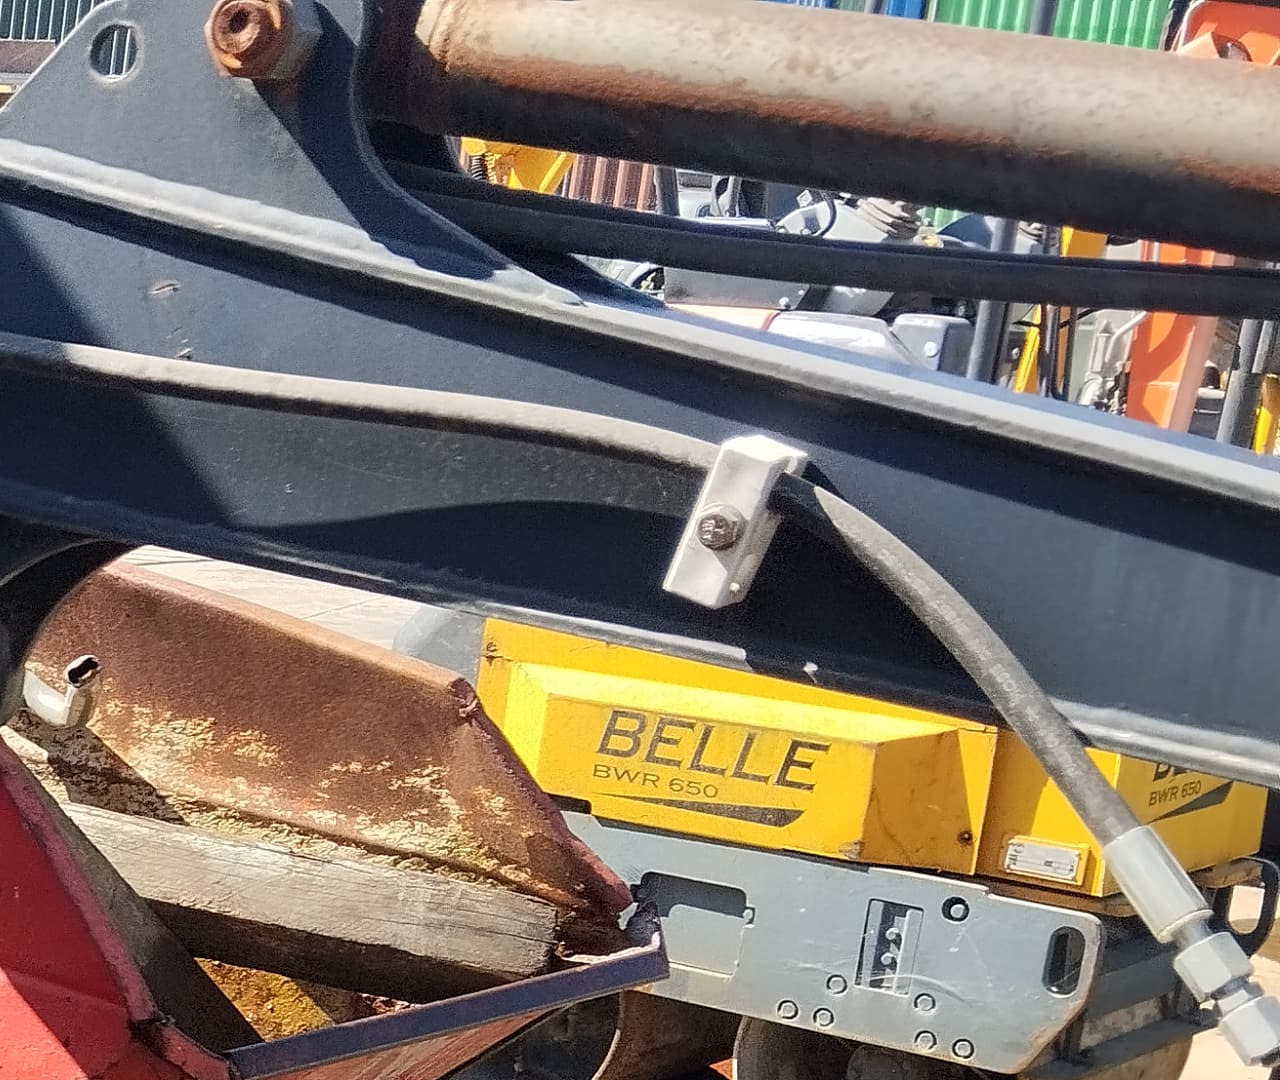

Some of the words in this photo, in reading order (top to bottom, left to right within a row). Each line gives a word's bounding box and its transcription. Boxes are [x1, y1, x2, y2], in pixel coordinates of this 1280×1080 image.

[596, 708, 833, 794] BELLE
[593, 763, 661, 789] BWR
[668, 777, 720, 798] 650
[1148, 785, 1180, 807] BWR
[1180, 780, 1202, 799] 650
